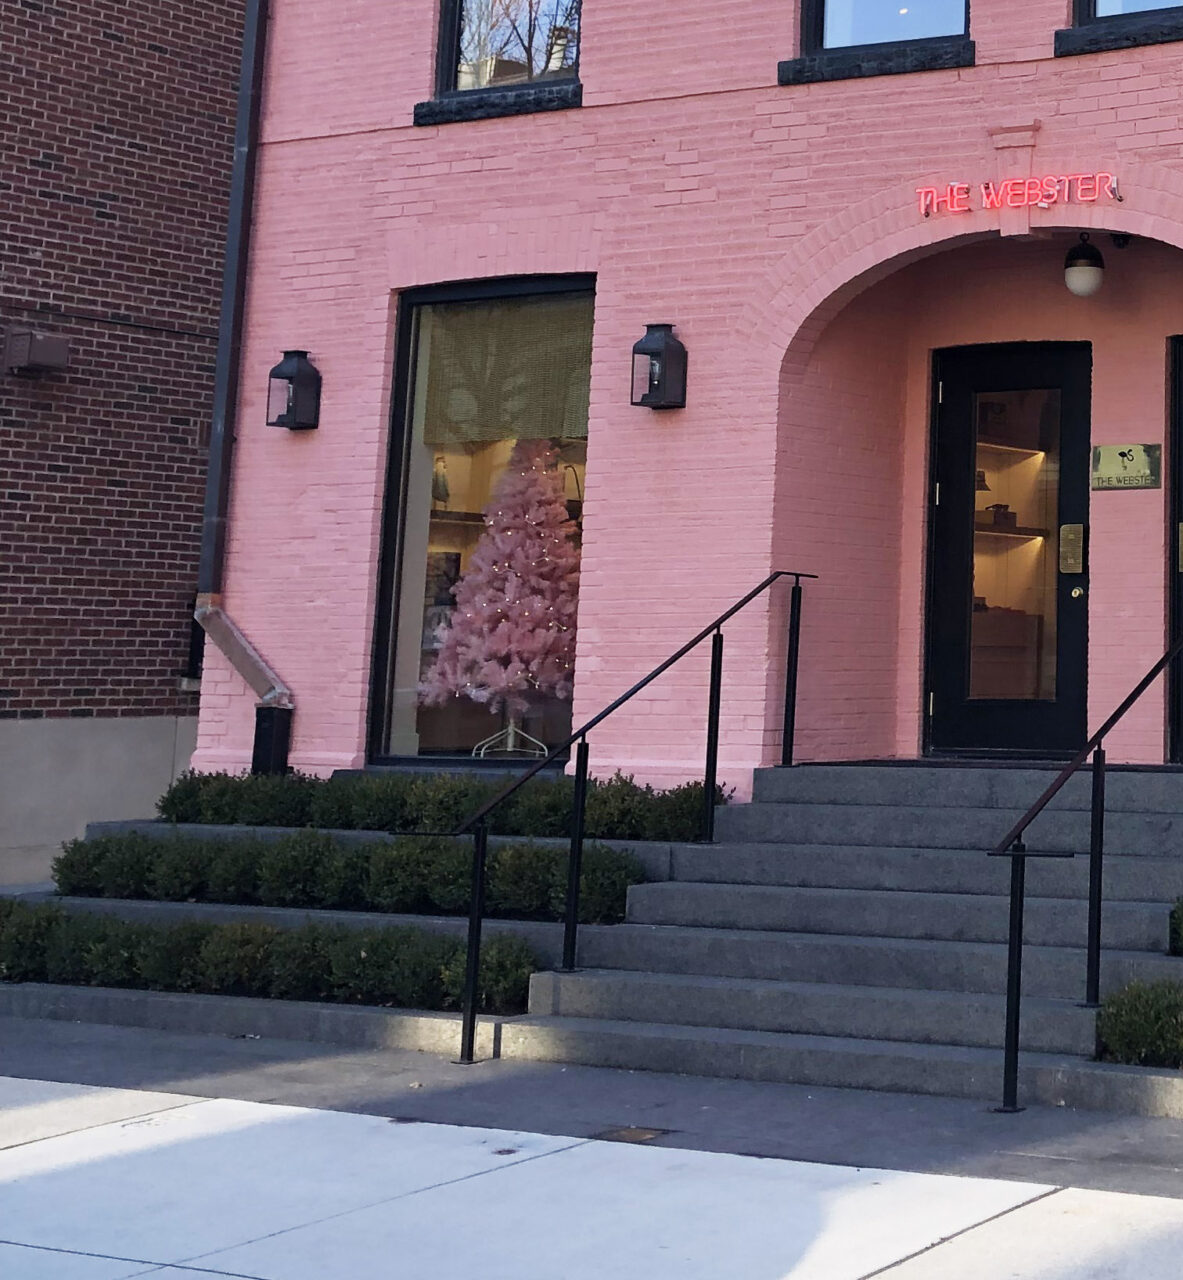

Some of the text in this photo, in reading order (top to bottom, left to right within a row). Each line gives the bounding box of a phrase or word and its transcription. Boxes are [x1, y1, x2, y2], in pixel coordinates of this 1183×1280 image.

[916, 172, 1115, 214] THE WEBSTER
[1096, 476, 1113, 486] THE
